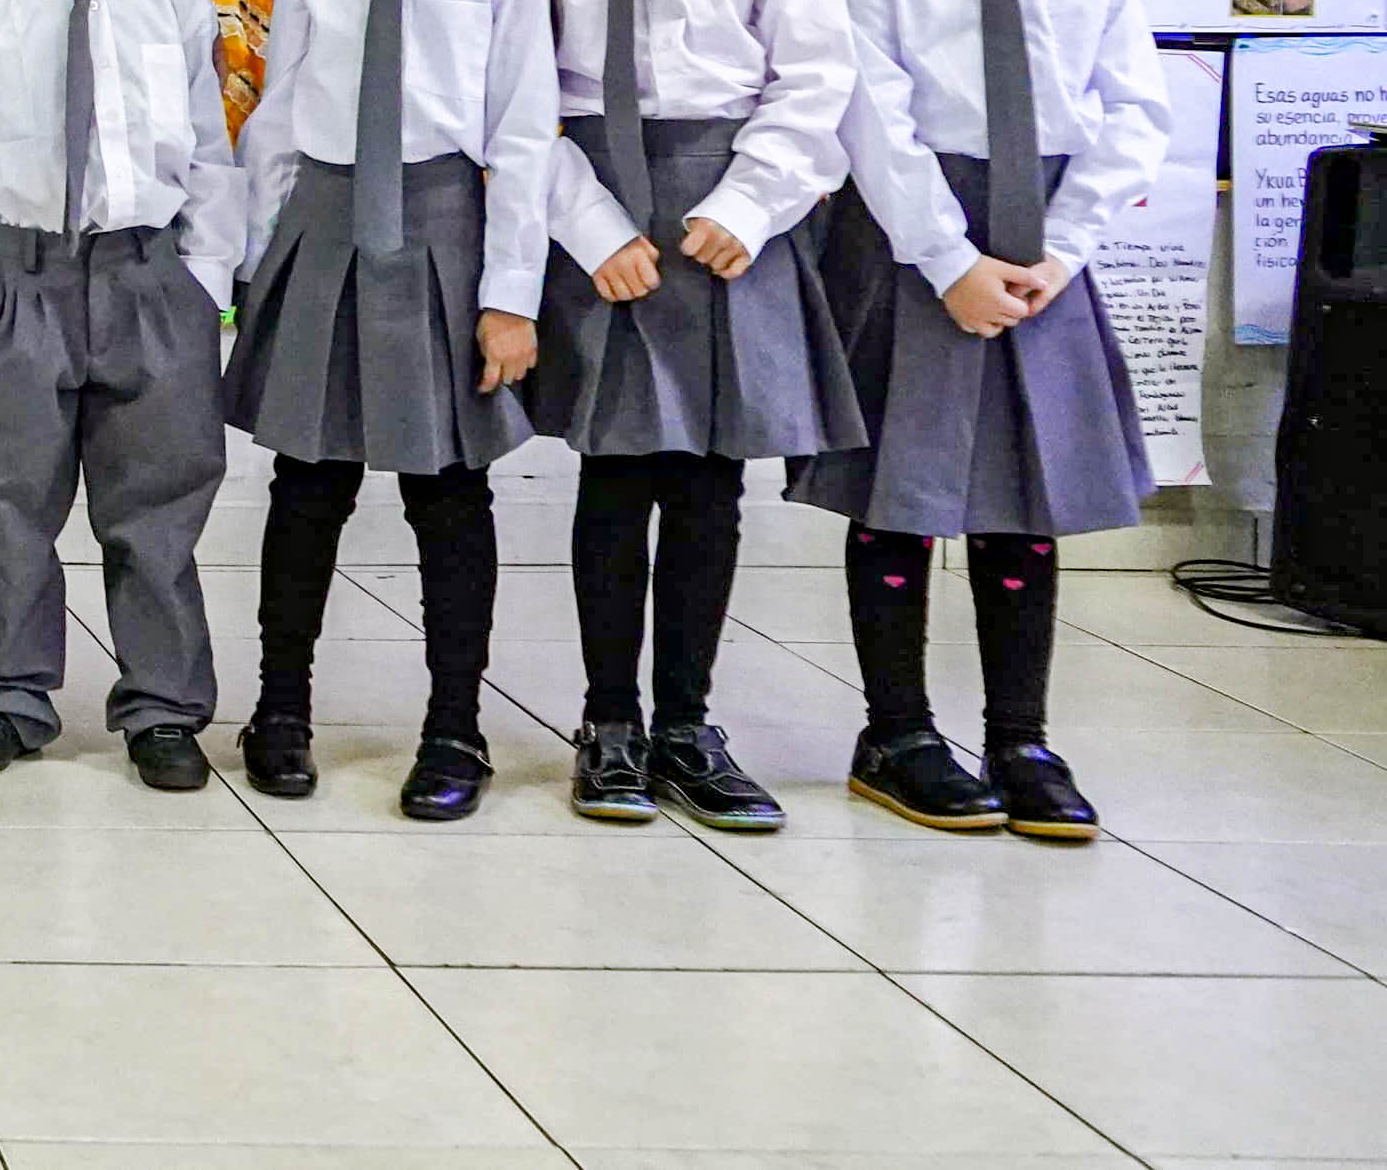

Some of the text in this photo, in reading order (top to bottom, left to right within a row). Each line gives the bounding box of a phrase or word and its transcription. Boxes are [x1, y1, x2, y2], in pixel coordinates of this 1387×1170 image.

[1254, 82, 1297, 103] Esas
[1301, 89, 1349, 108] aguas
[1355, 89, 1375, 102] no
[1255, 111, 1272, 124] su
[1255, 129, 1354, 147] abundancia
[1255, 168, 1294, 189] Ykua
[1255, 196, 1274, 208] un
[1255, 213, 1270, 227] la
